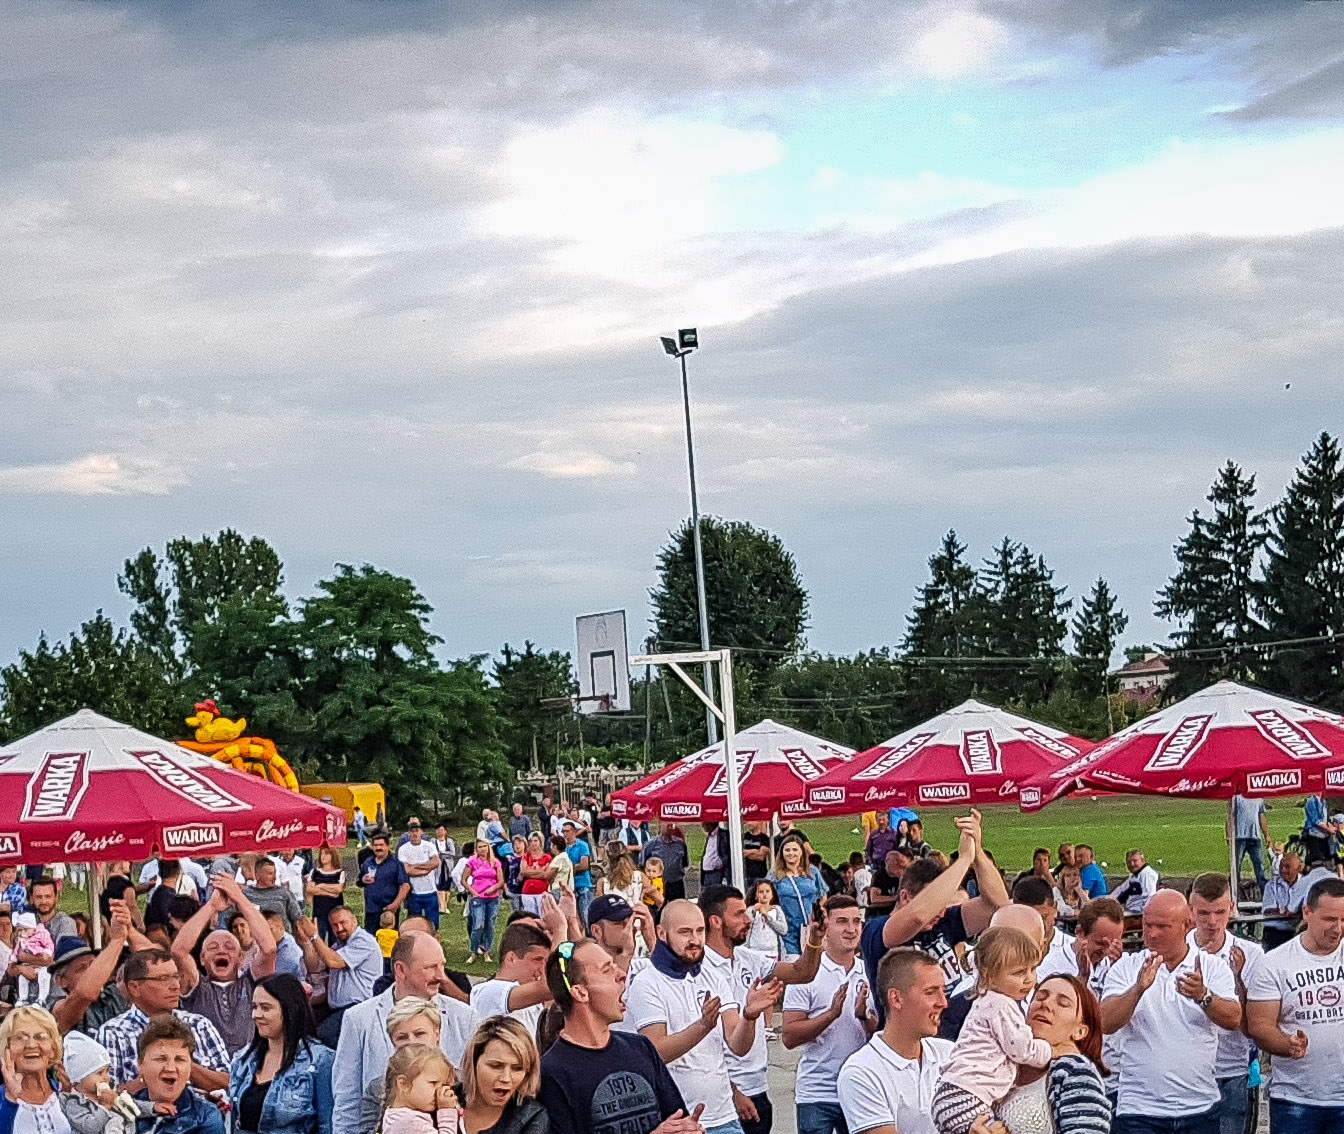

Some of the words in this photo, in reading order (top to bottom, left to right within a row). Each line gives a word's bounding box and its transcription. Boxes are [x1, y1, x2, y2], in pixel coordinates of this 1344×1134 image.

[1156, 716, 1205, 766] WARKA
[1256, 711, 1317, 755] WARKA
[866, 732, 932, 777] WARKA
[968, 731, 993, 772] WARKA
[787, 751, 820, 780] ARKA
[32, 754, 81, 817] WARKA
[138, 752, 234, 808] WARKA
[922, 787, 966, 798] WARKA
[1250, 771, 1297, 788] WARKA
[812, 790, 843, 801] WARKA
[864, 786, 897, 801] Classic
[664, 805, 699, 815] WARKA
[64, 829, 126, 854] Classic
[167, 828, 218, 846] WARKA
[255, 817, 304, 843] Classic
[1297, 990, 1314, 1007] 19
[1294, 1008, 1323, 1020] GREAT
[606, 1074, 636, 1097] 1979
